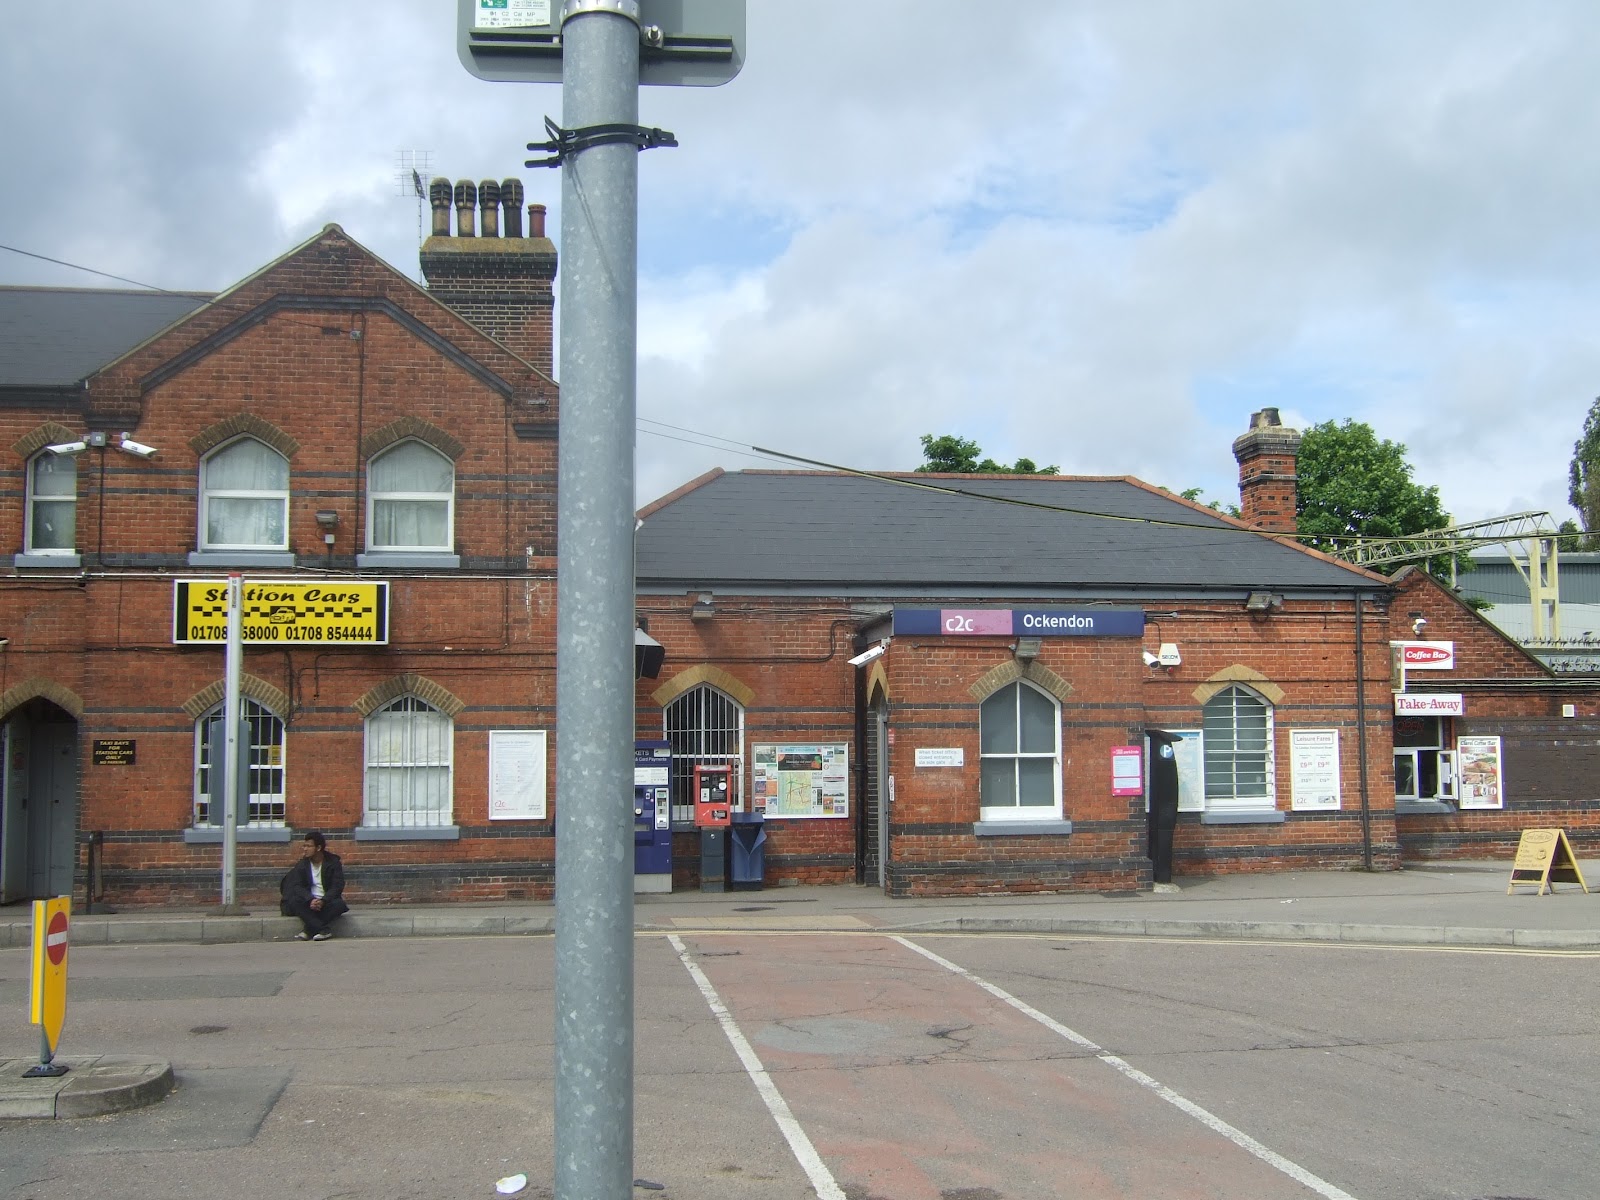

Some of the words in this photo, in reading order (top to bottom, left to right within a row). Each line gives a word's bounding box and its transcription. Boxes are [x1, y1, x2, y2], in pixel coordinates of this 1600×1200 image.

[204, 588, 295, 602] Sttion
[303, 589, 360, 604] Cars
[945, 615, 974, 632] c2c
[1023, 614, 1094, 628] Ockendon
[241, 626, 279, 640] 58000
[285, 626, 322, 640] 01708
[326, 626, 372, 640] 854444
[1406, 651, 1431, 660] Coffee
[1432, 651, 1448, 659] Bar
[1397, 698, 1460, 712] Take-Away
[494, 800, 505, 808] c2c
